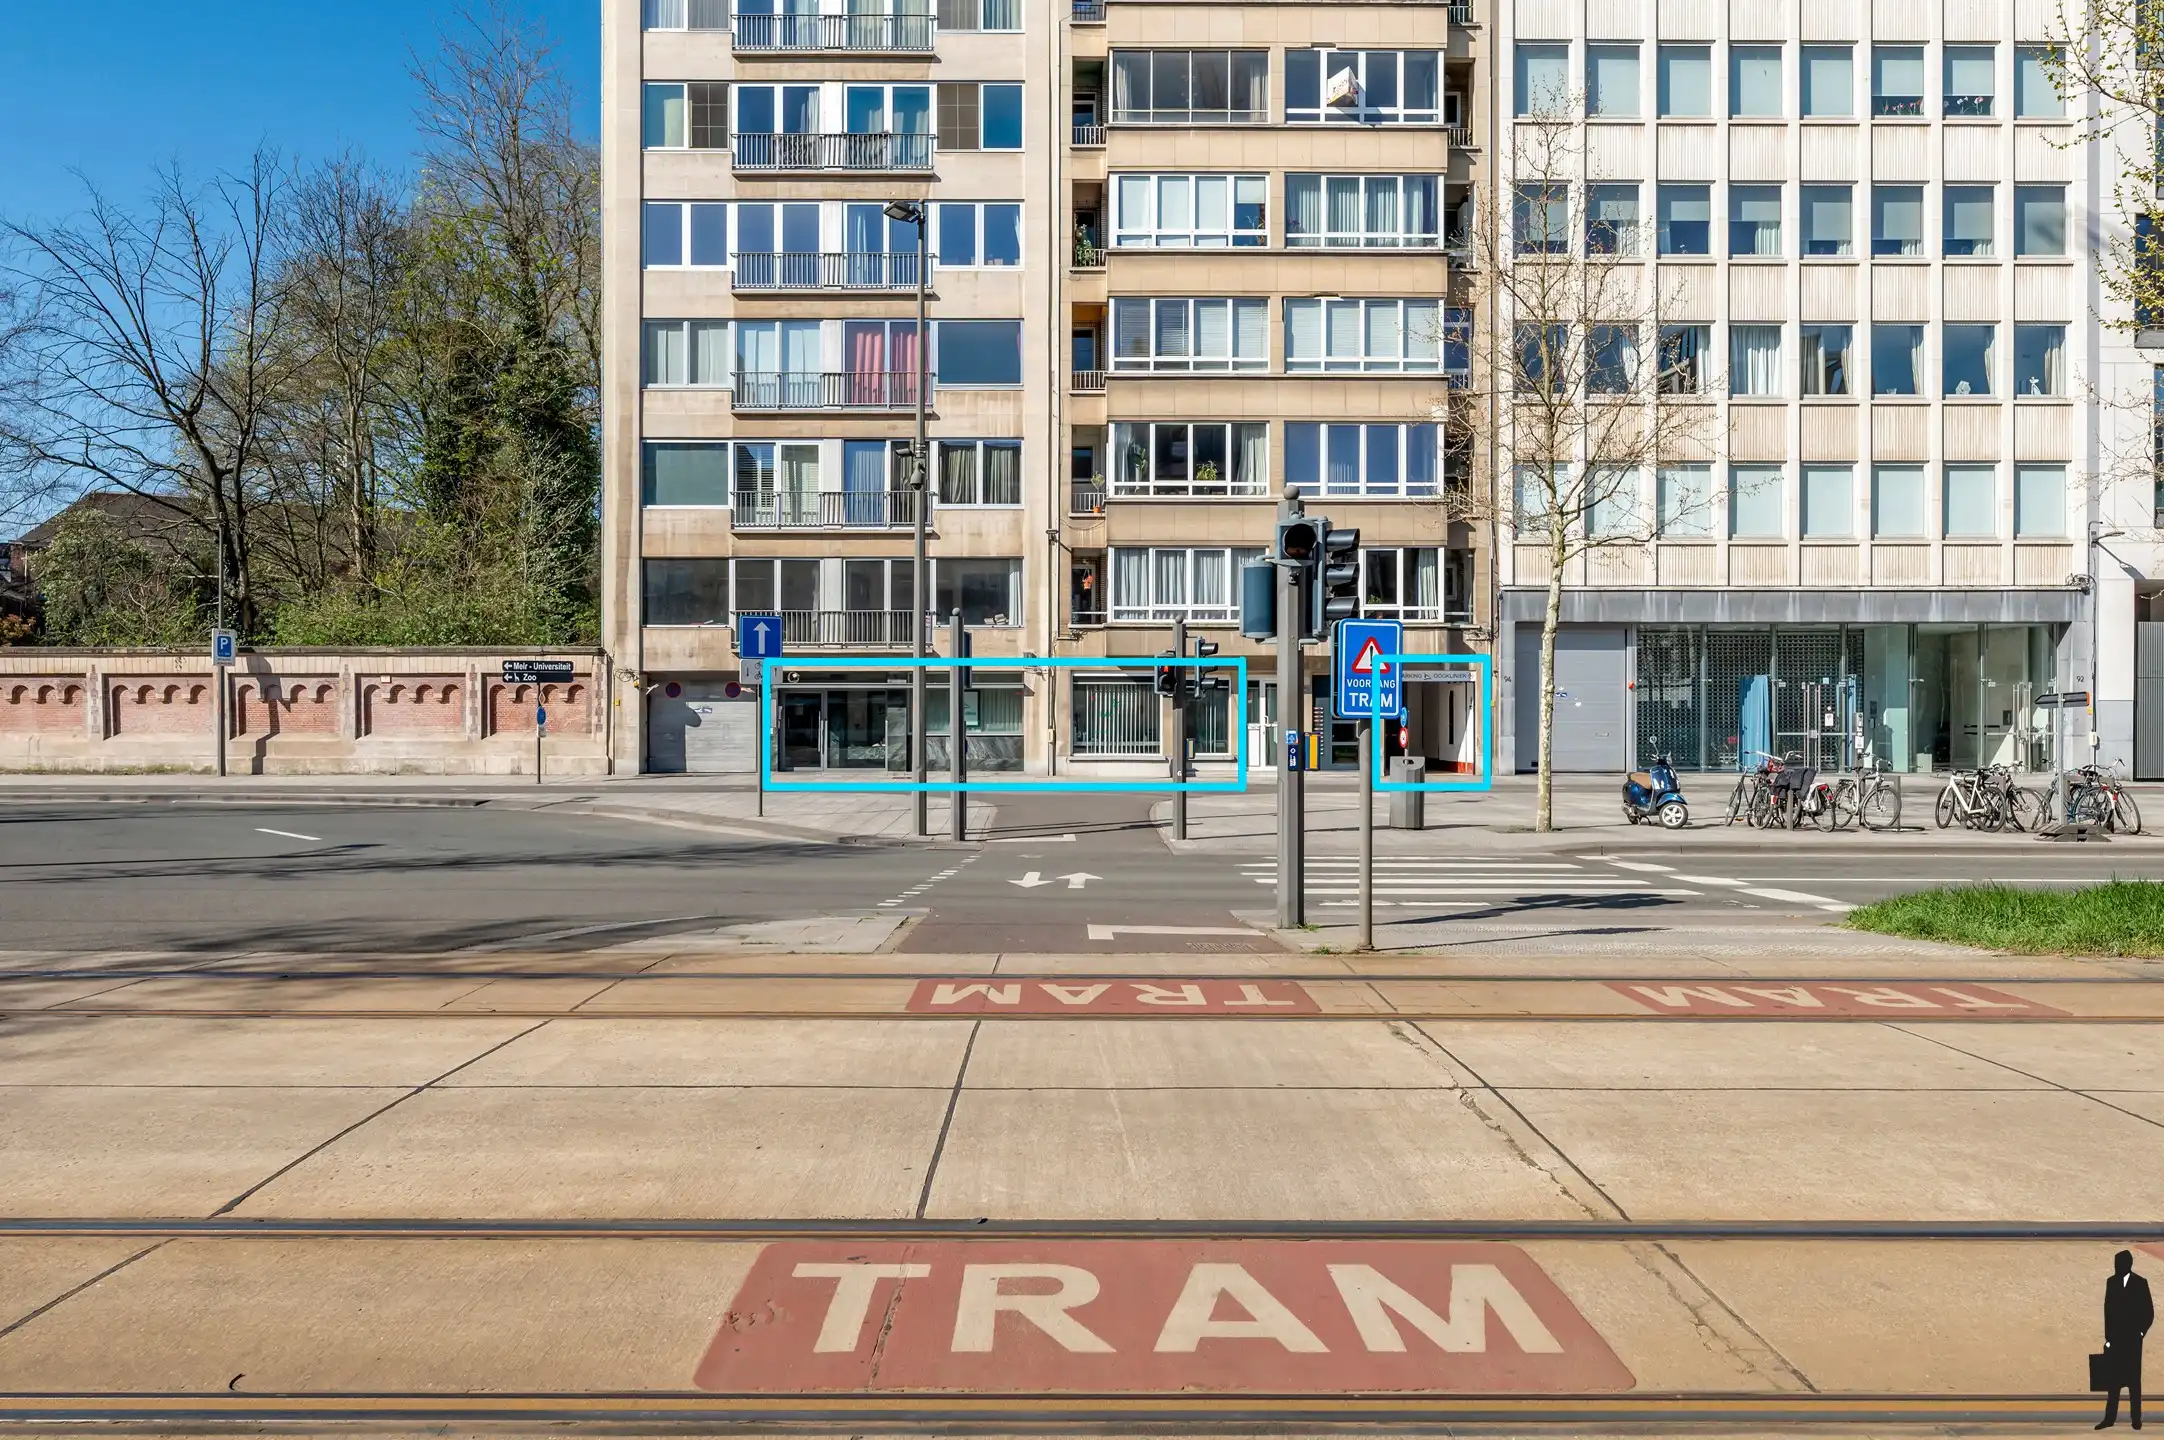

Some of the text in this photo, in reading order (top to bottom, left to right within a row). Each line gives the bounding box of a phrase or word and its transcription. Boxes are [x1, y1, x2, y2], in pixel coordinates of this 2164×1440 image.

[513, 662, 528, 670] Meir
[533, 662, 571, 671] Universiteit
[523, 673, 536, 681] Zoo
[1346, 678, 1396, 689] VOORANG
[930, 983, 1296, 1006] TRAM
[1629, 985, 2031, 1009] TRAM
[791, 1263, 1565, 1355] TRAM
